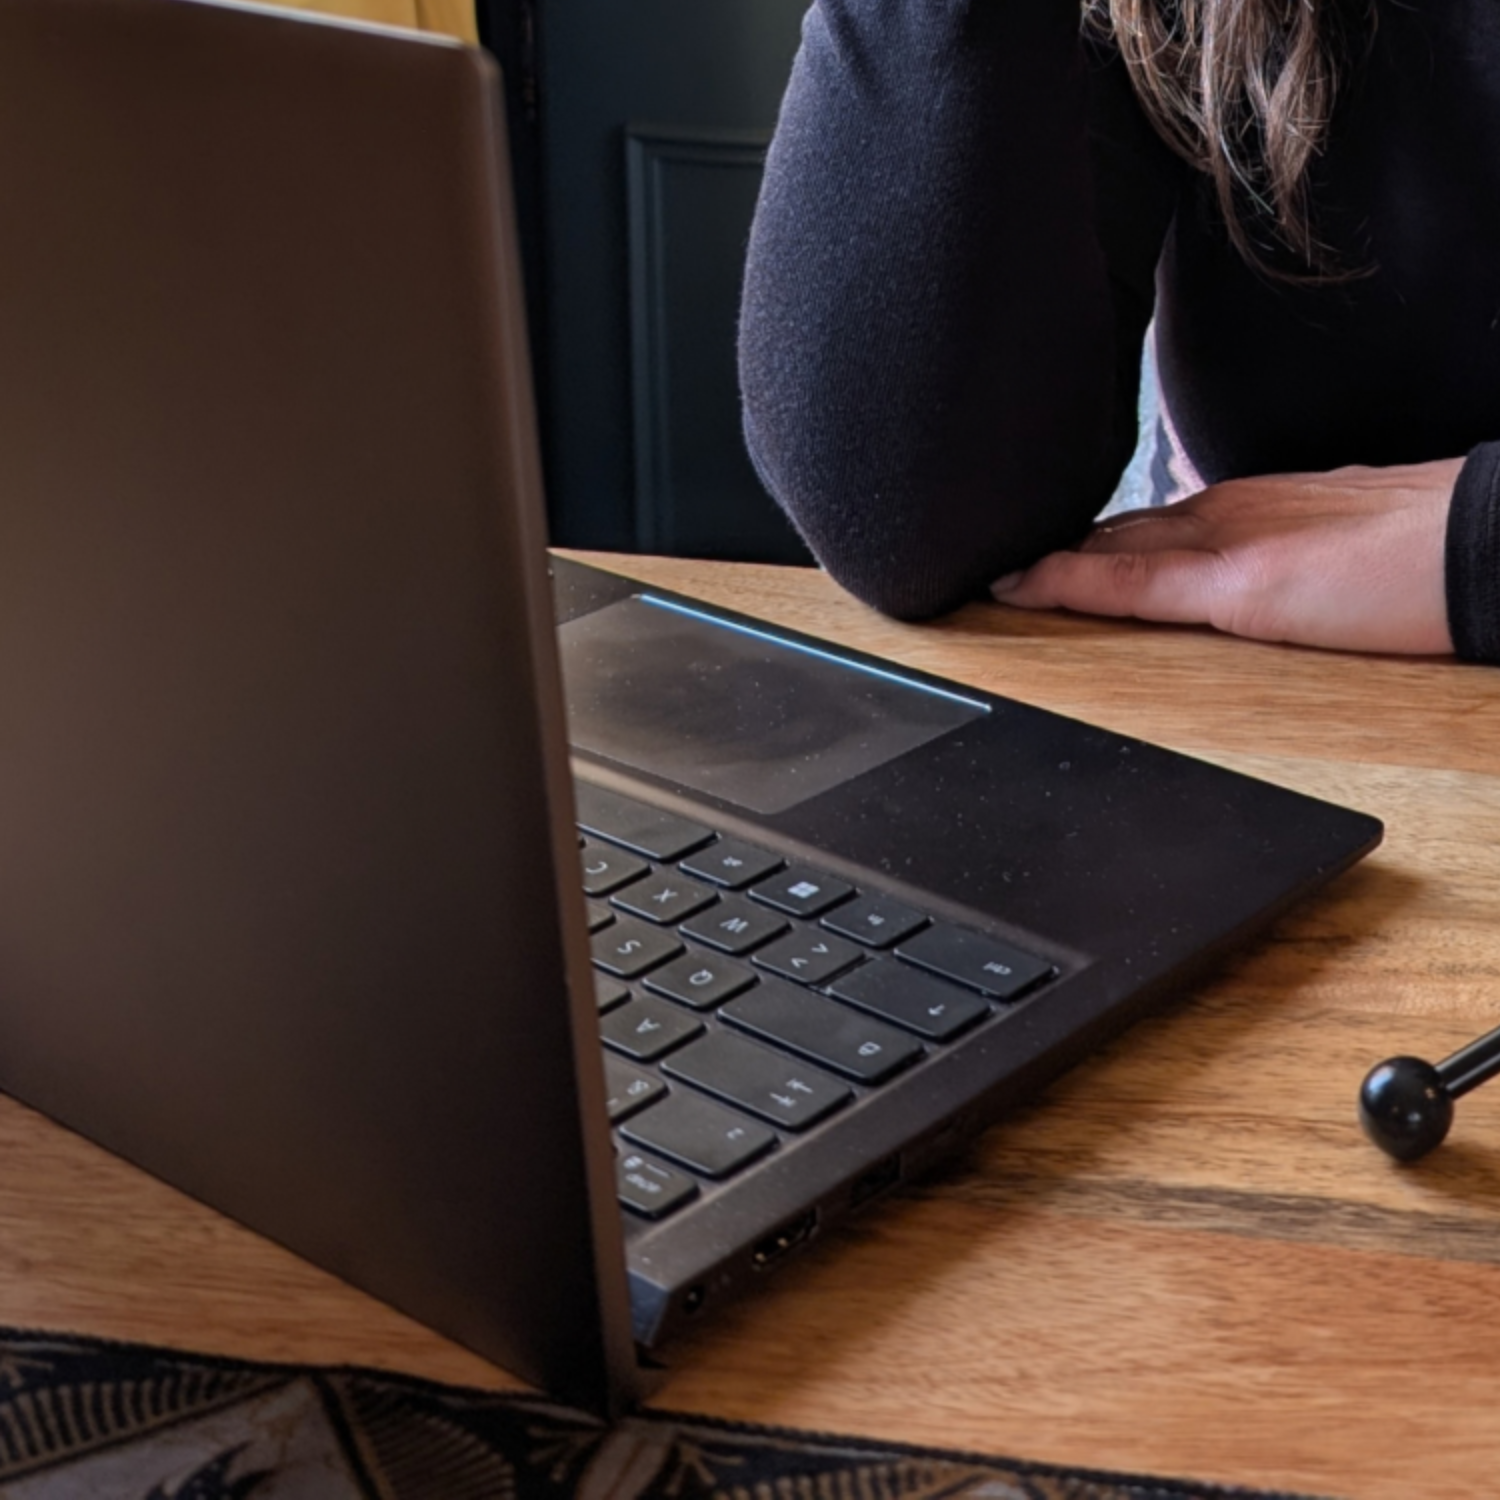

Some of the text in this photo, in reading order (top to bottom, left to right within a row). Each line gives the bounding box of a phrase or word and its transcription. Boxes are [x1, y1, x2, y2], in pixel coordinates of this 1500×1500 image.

[653, 887, 678, 903] X
[719, 917, 749, 933] W
[617, 939, 641, 955] S
[689, 968, 714, 986] Q
[635, 1018, 662, 1034] A
